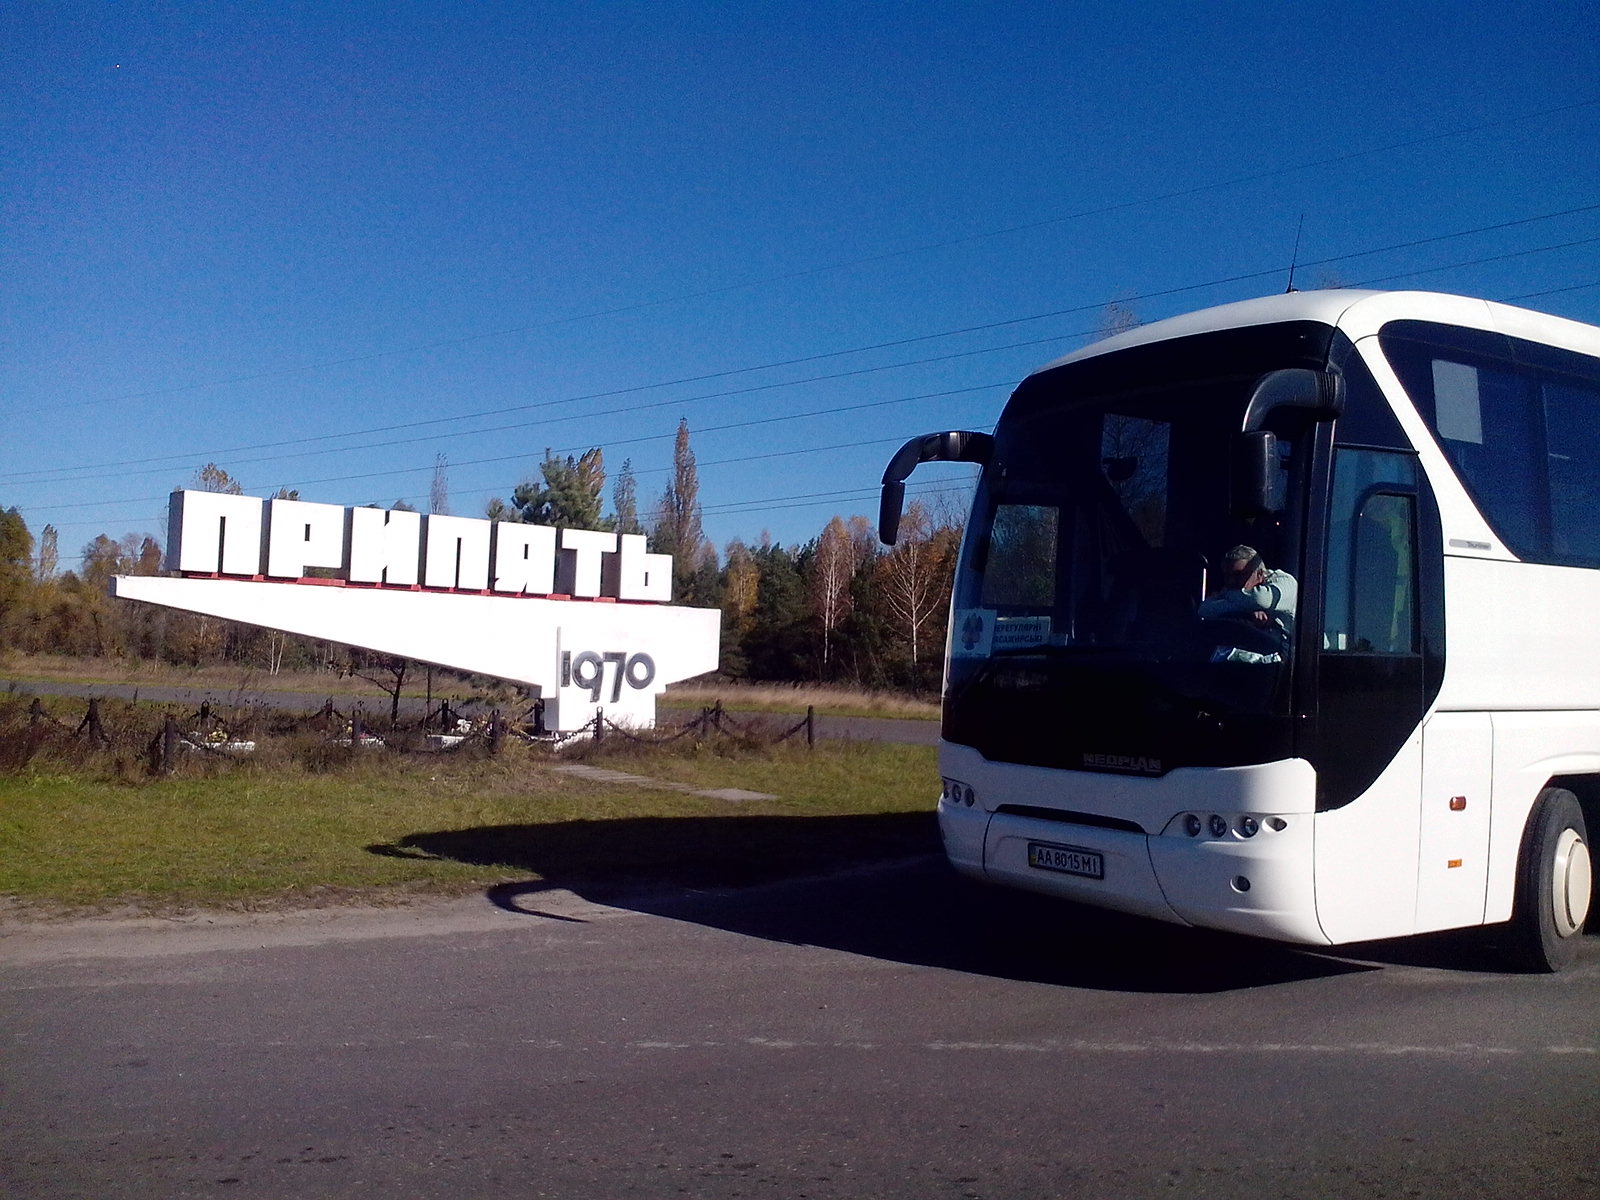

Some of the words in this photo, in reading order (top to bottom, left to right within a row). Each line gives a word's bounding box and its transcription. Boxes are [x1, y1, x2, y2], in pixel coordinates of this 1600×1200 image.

[170, 490, 672, 601] ПРИПЯТЬ
[560, 651, 656, 703] 1970
[1083, 753, 1161, 771] NEOPLAN
